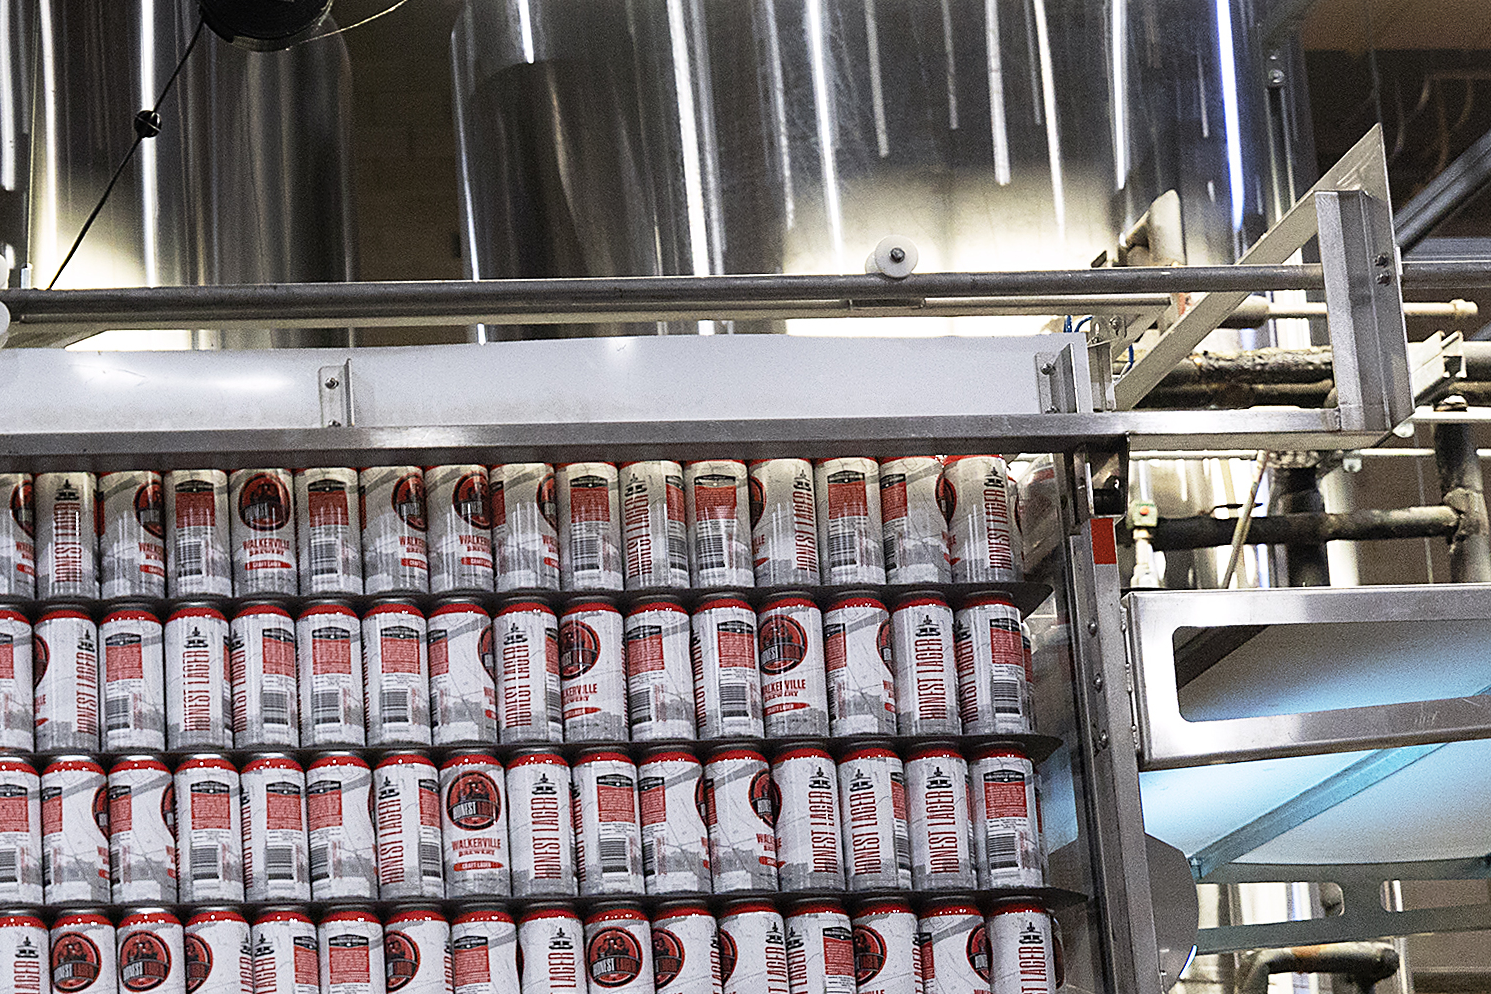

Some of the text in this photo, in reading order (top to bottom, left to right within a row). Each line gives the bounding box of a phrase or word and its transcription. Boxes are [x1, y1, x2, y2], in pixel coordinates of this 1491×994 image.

[793, 491, 817, 572] HONEST LAGER
[983, 489, 1012, 570] HONEST LAGER
[183, 650, 210, 731] HONEST LAGER
[915, 639, 947, 720] HONEST LAGER
[379, 799, 404, 885] HONEST LAGER
[452, 838, 500, 850] WALKERVILLE
[532, 796, 561, 879] HONEST LAGER
[809, 792, 837, 873] HONEST LAGER
[850, 791, 881, 875] HONEST LAGER
[926, 791, 959, 873] HONEST LAGER
[549, 952, 576, 988] LAGER
[1019, 947, 1046, 983] LAGER
